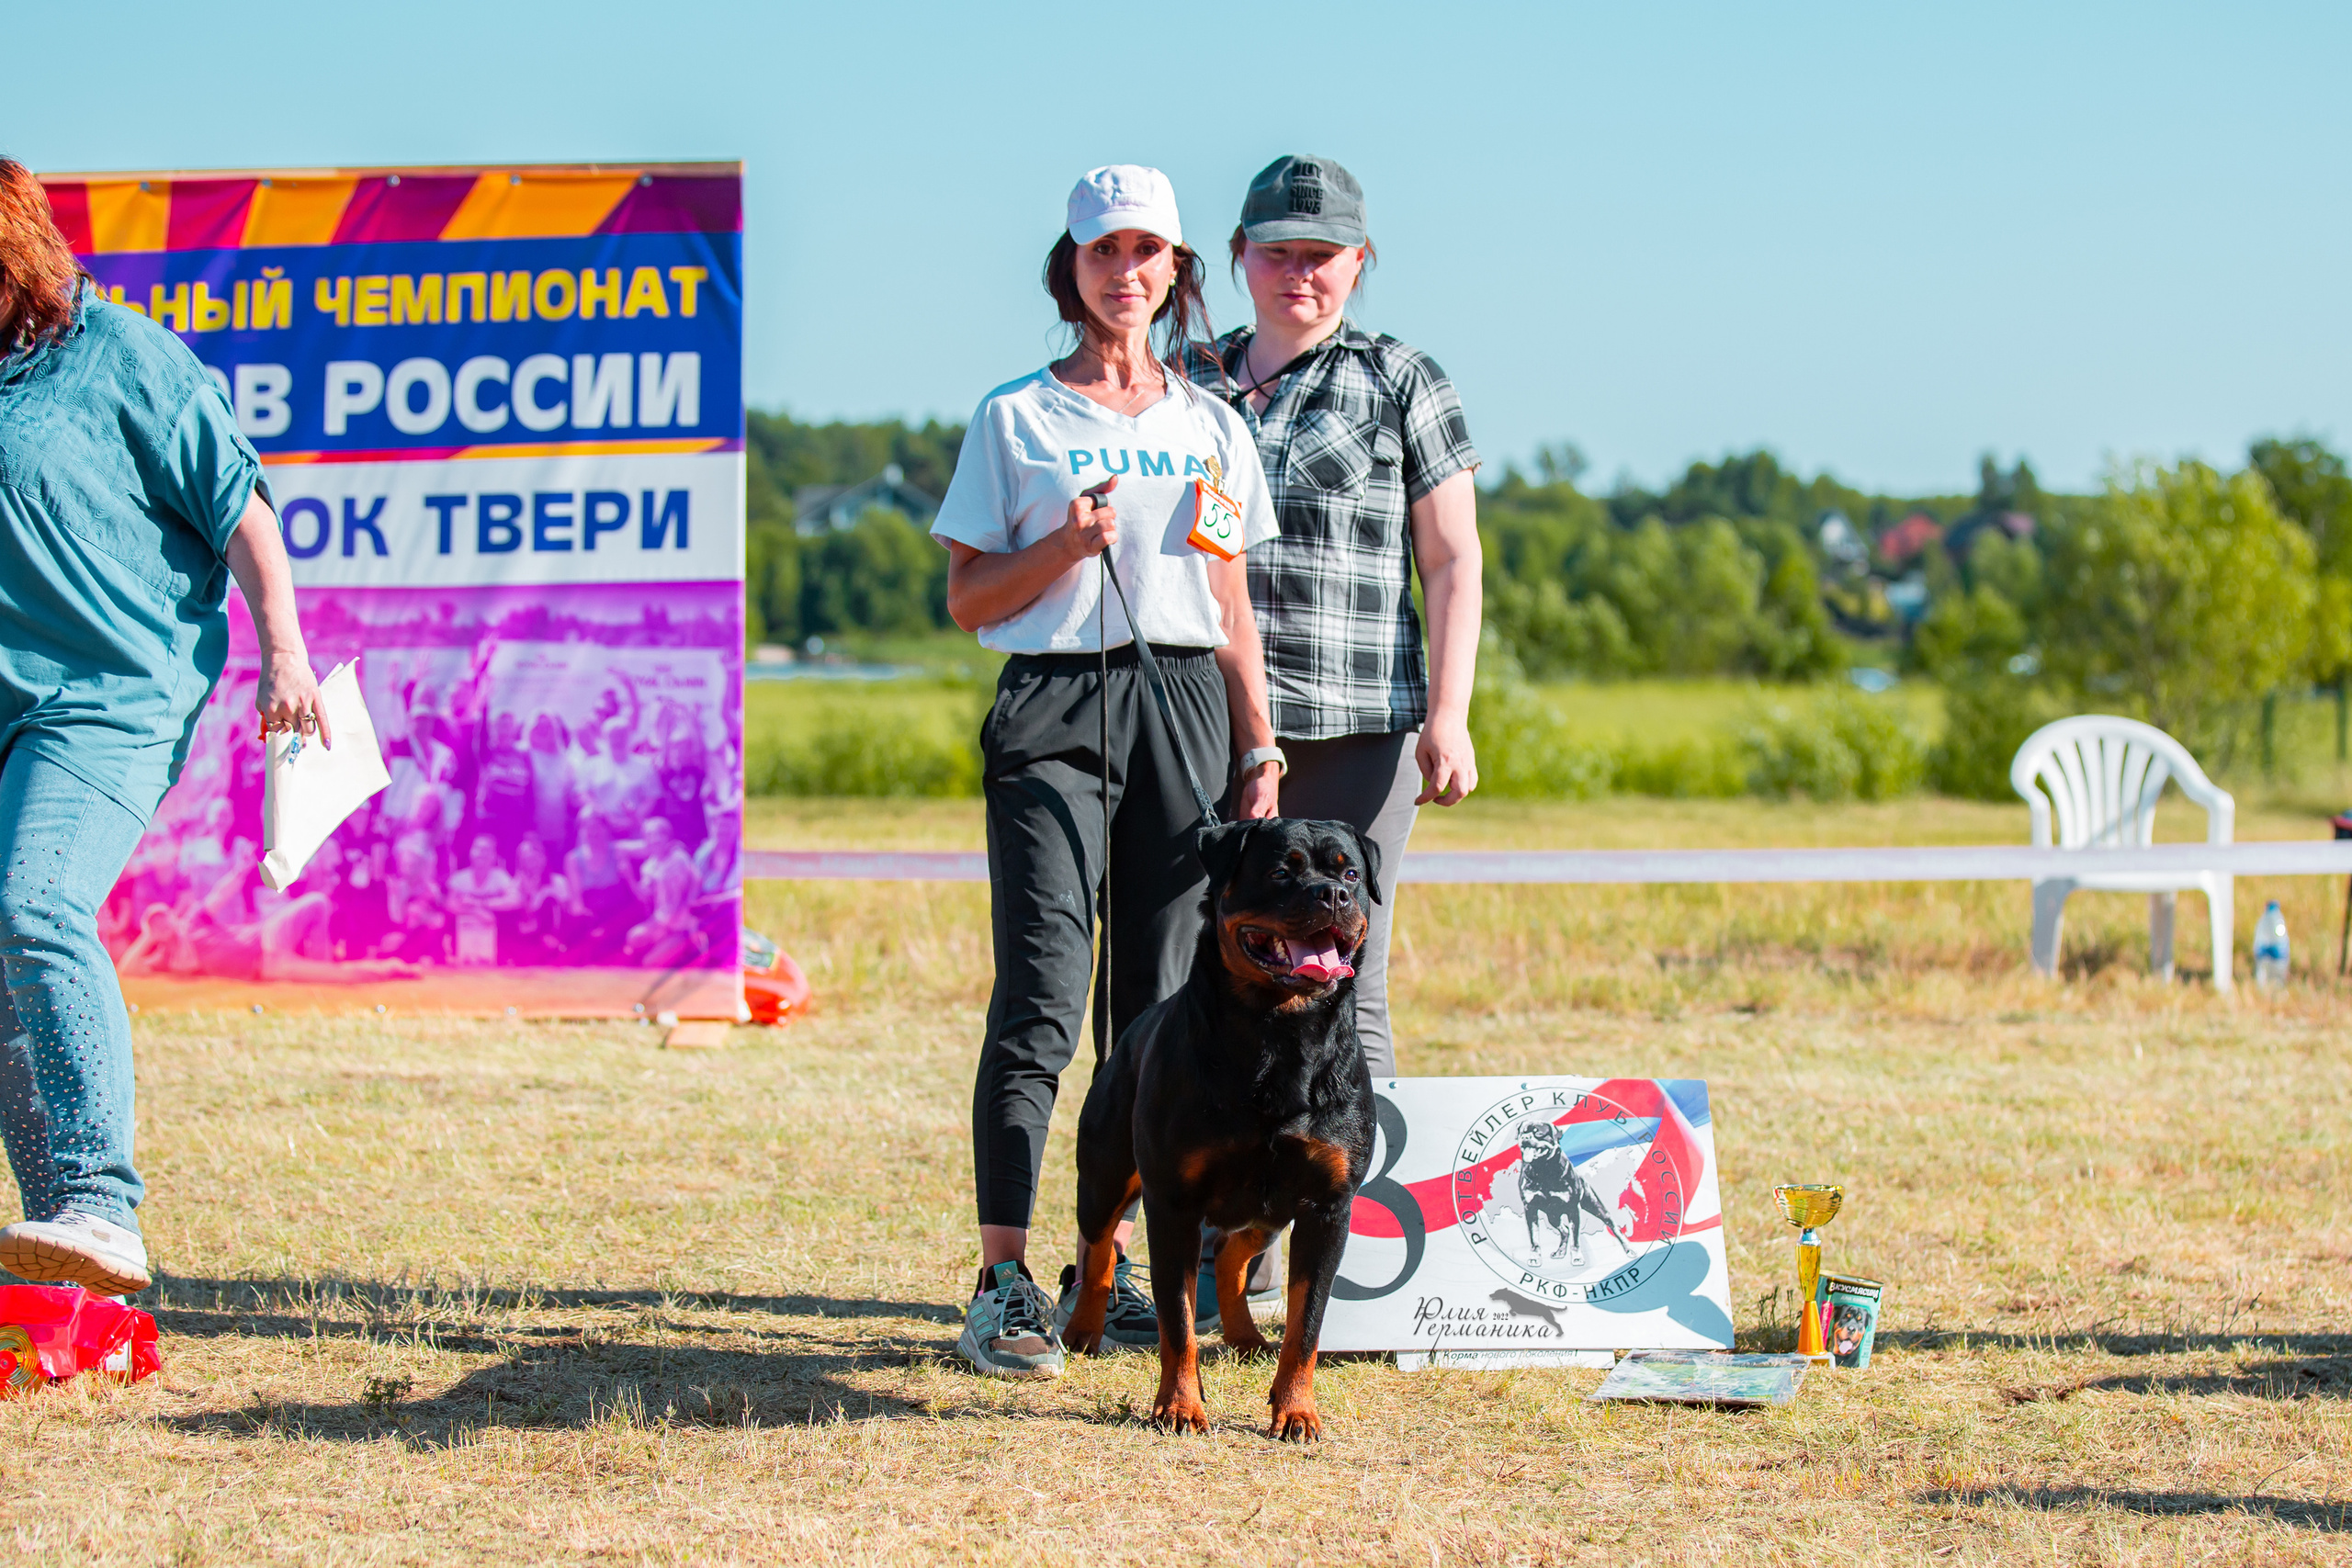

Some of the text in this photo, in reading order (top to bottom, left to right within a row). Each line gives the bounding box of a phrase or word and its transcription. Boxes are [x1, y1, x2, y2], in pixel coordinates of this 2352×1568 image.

[98, 265, 708, 333] ЬНЫЙ ЧЕМПИОНАТ
[208, 352, 702, 438] В РОССИИ
[1068, 447, 1211, 481] PUMA
[424, 490, 689, 555] ТВЕРИ
[1204, 502, 1234, 539] 55
[1457, 1091, 1679, 1247] РОТВЕЙЛЕР КЛУБ РОССИИ
[1519, 1267, 1641, 1300] РКФ-НКПР
[1413, 1296, 1510, 1322] Юлия 2022
[1413, 1312, 1554, 1350] Германика
[1443, 1350, 1478, 1360] Корма
